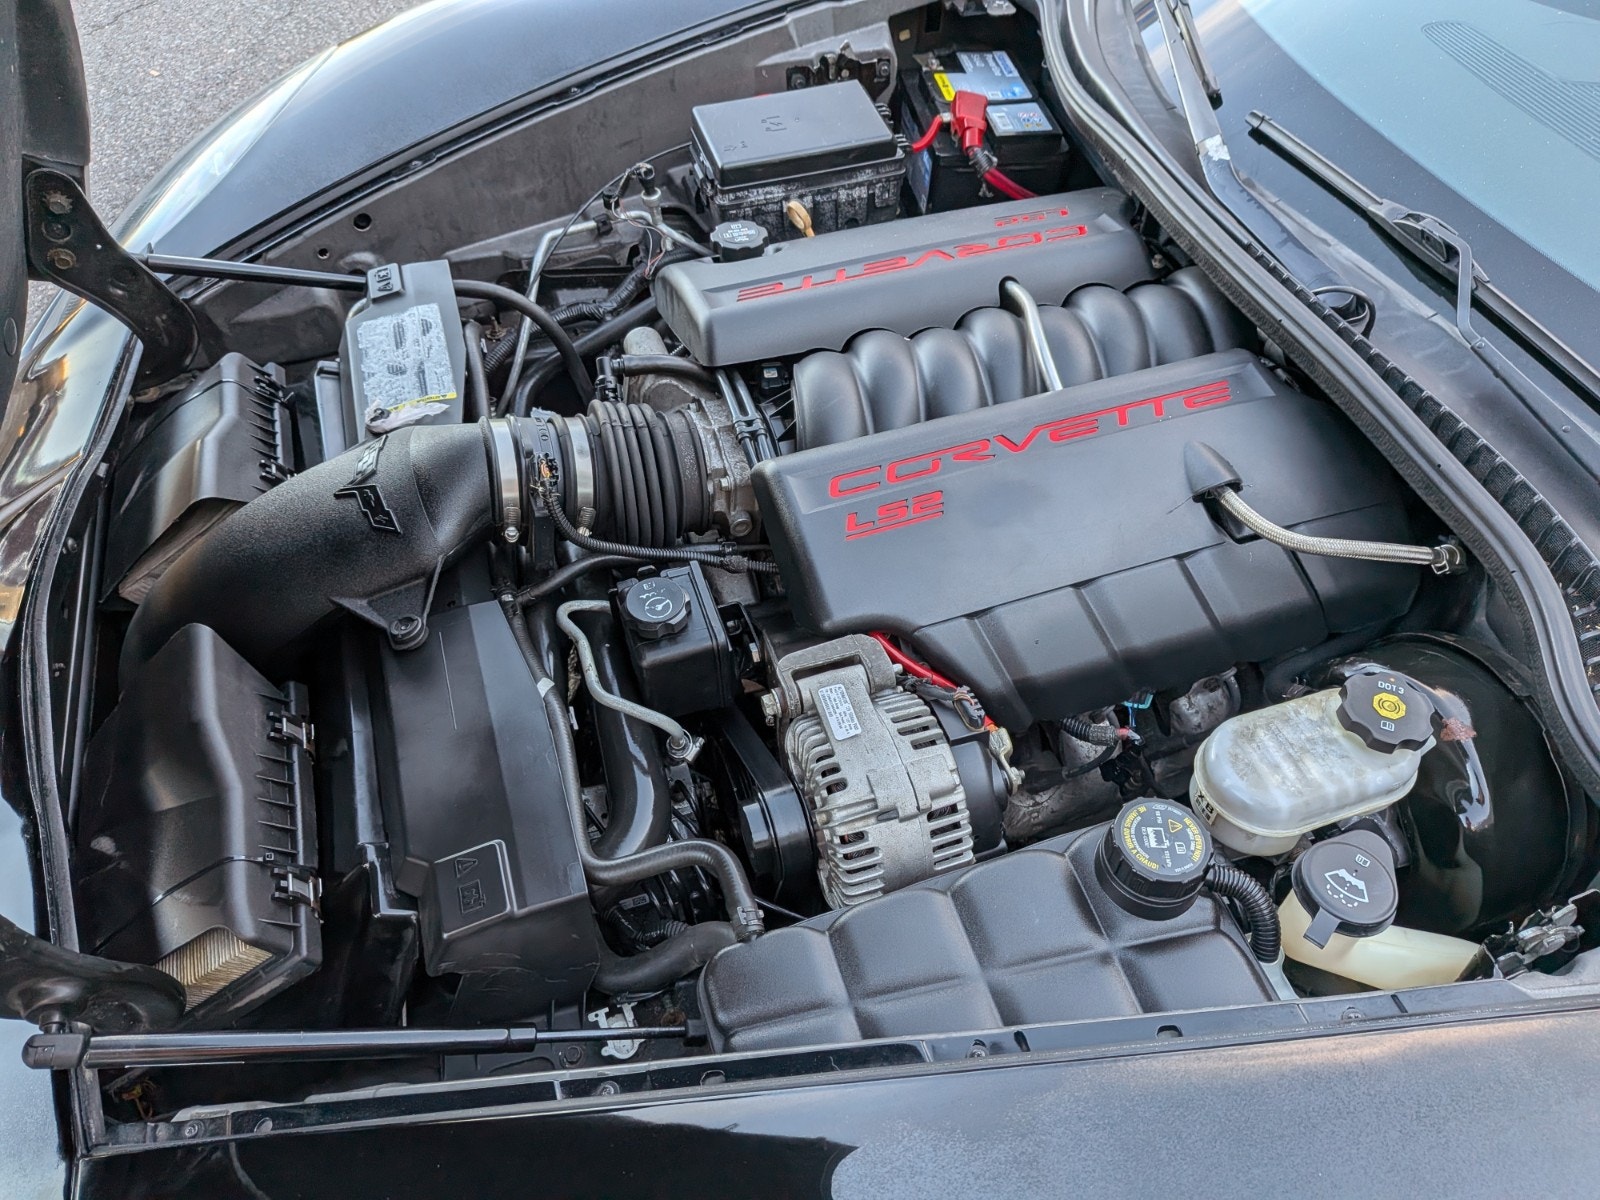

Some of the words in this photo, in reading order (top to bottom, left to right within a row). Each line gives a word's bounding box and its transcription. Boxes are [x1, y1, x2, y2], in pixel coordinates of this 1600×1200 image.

[735, 224, 1088, 302] CORVETTE
[829, 380, 1232, 499] CORVETTE
[845, 490, 944, 535] LS2
[1377, 681, 1397, 692] DOT
[1398, 686, 1405, 695] 3
[1124, 809, 1139, 828] JAMAIS
[1135, 853, 1159, 871] CHAUD!
[1183, 817, 1200, 835] NEVER
